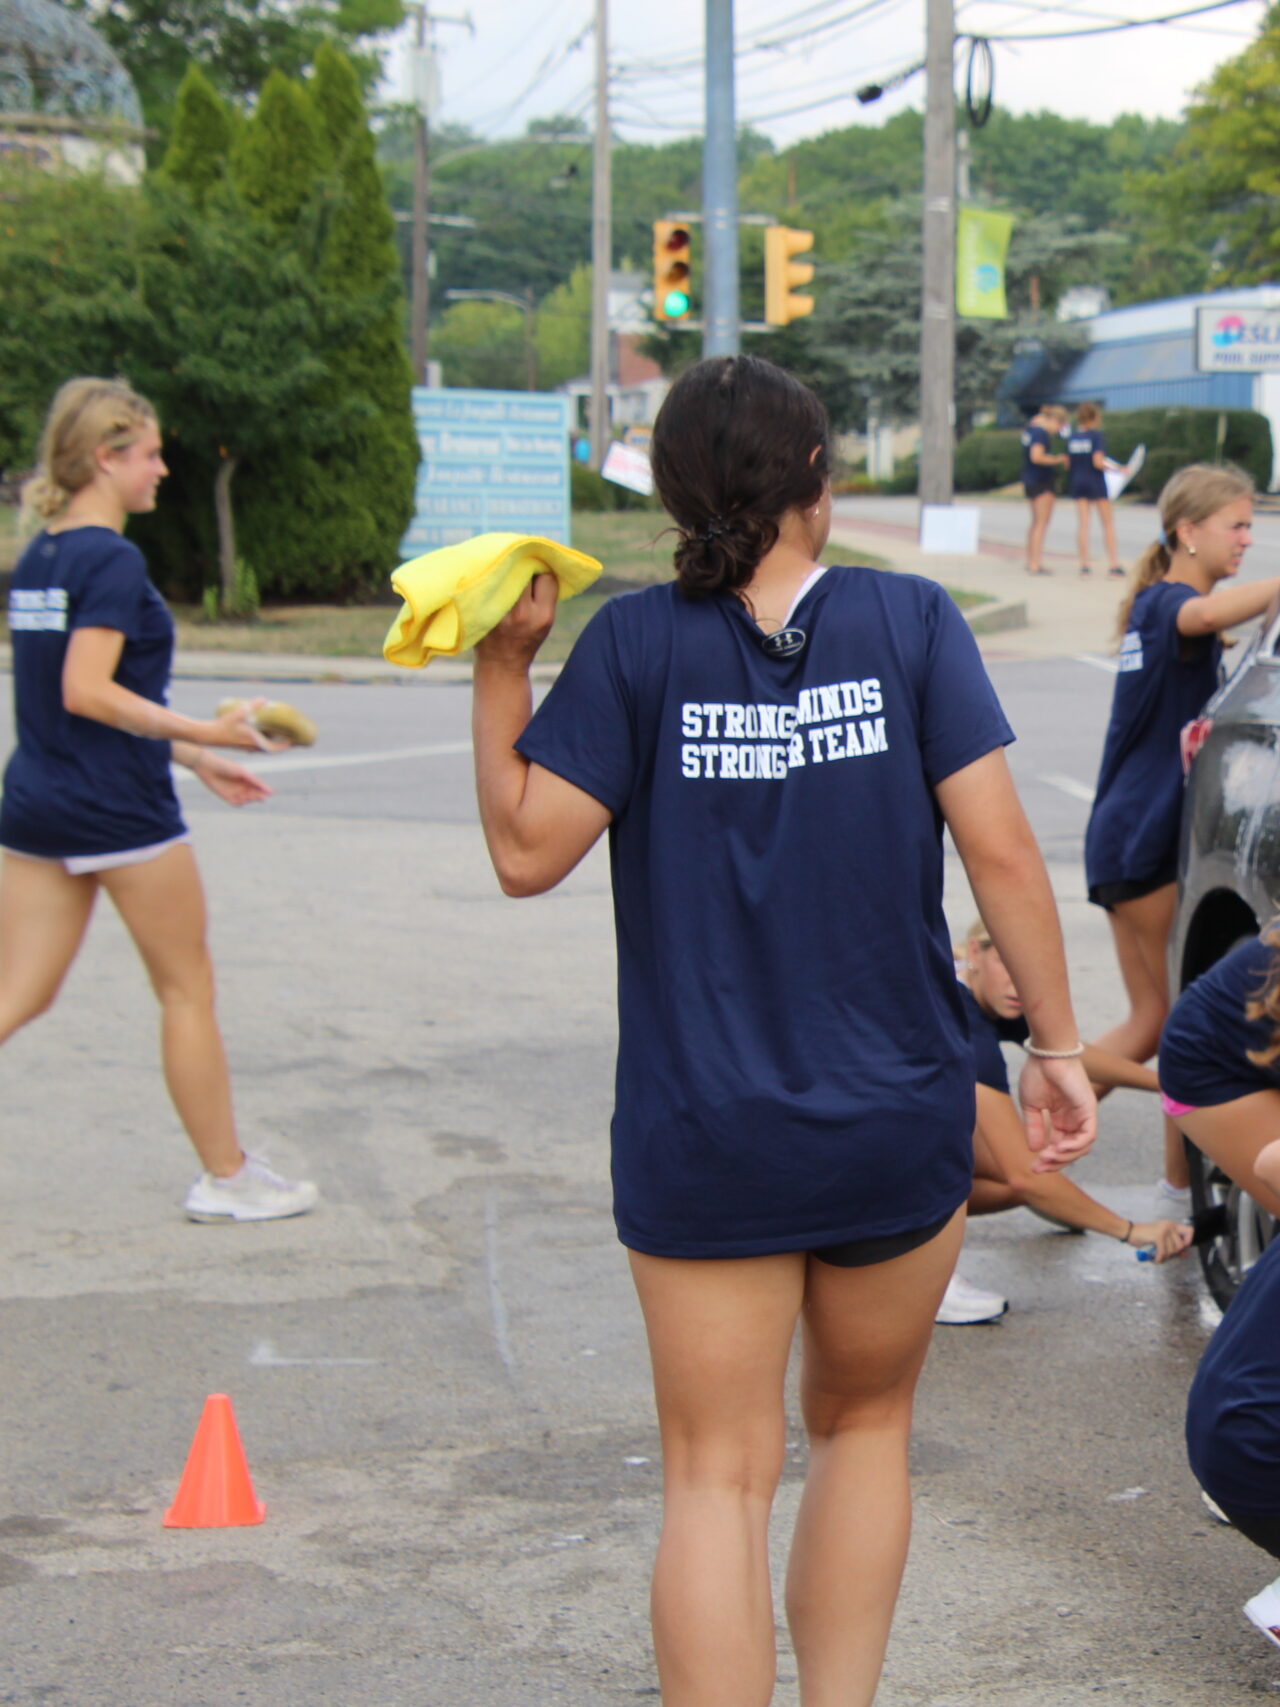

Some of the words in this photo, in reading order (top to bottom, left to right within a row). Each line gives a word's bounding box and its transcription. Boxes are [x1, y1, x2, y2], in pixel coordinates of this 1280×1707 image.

[681, 703, 798, 740] STRONG
[681, 732, 806, 780] STRONGR
[808, 716, 889, 764] TEAM
